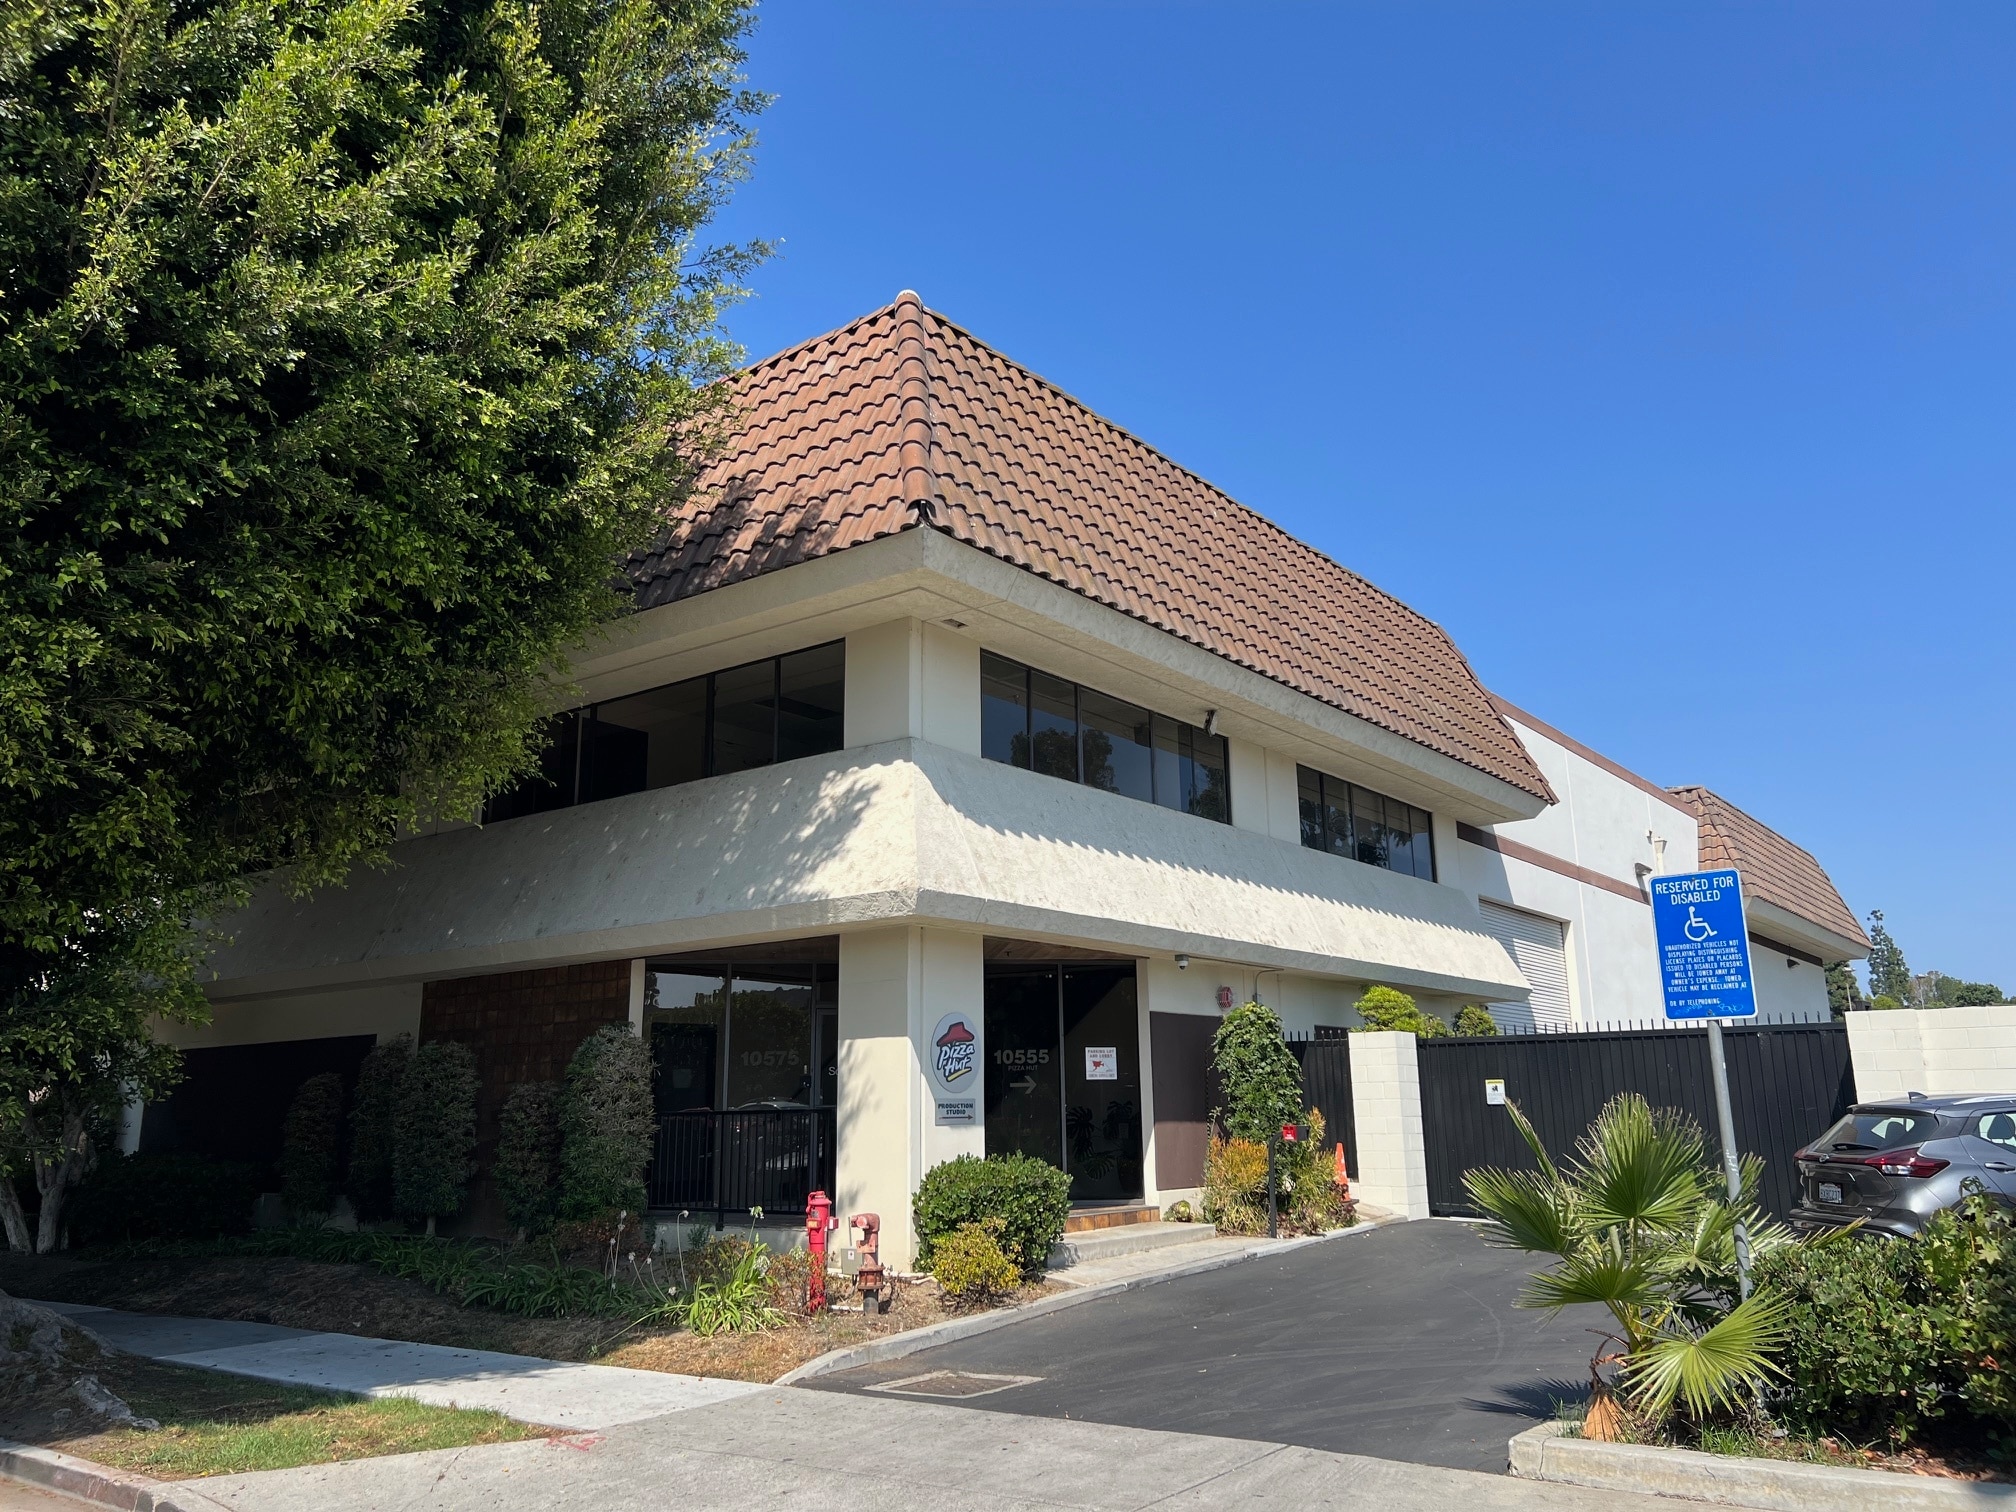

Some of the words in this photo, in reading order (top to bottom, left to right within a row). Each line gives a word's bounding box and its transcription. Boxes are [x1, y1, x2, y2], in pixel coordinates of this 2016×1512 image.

[1655, 878, 1709, 895] RESERVED
[1713, 875, 1734, 888] FOR
[1670, 889, 1721, 905] DISABLED
[1665, 943, 1701, 951] UNAUTHORIZED
[1703, 941, 1727, 949] VEHICLES
[1667, 950, 1696, 958] DISPLAYING
[1697, 947, 1738, 956] DISTINGUISHING
[1665, 957, 1685, 965] LICENSE
[1717, 953, 1743, 961] PLACARDS
[1694, 962, 1718, 970] DISABLED
[1720, 960, 1744, 968] PERSONS
[1687, 970, 1695, 978] BE
[1696, 969, 1713, 977] TOWED
[1715, 968, 1728, 976] AWAY
[1730, 967, 1736, 975] AT
[1671, 977, 1694, 986] OWNER'S
[1724, 974, 1742, 982] TOWED
[1667, 985, 1688, 993] VEHICLE
[1710, 982, 1739, 990] RECLAIMED
[1679, 999, 1685, 1007] BY
[1687, 997, 1720, 1006] TELEPHONING
[740, 1050, 799, 1066] 10575
[937, 1042, 975, 1070] Pizza
[993, 1049, 1050, 1065] 10555
[944, 1056, 971, 1077] Hut
